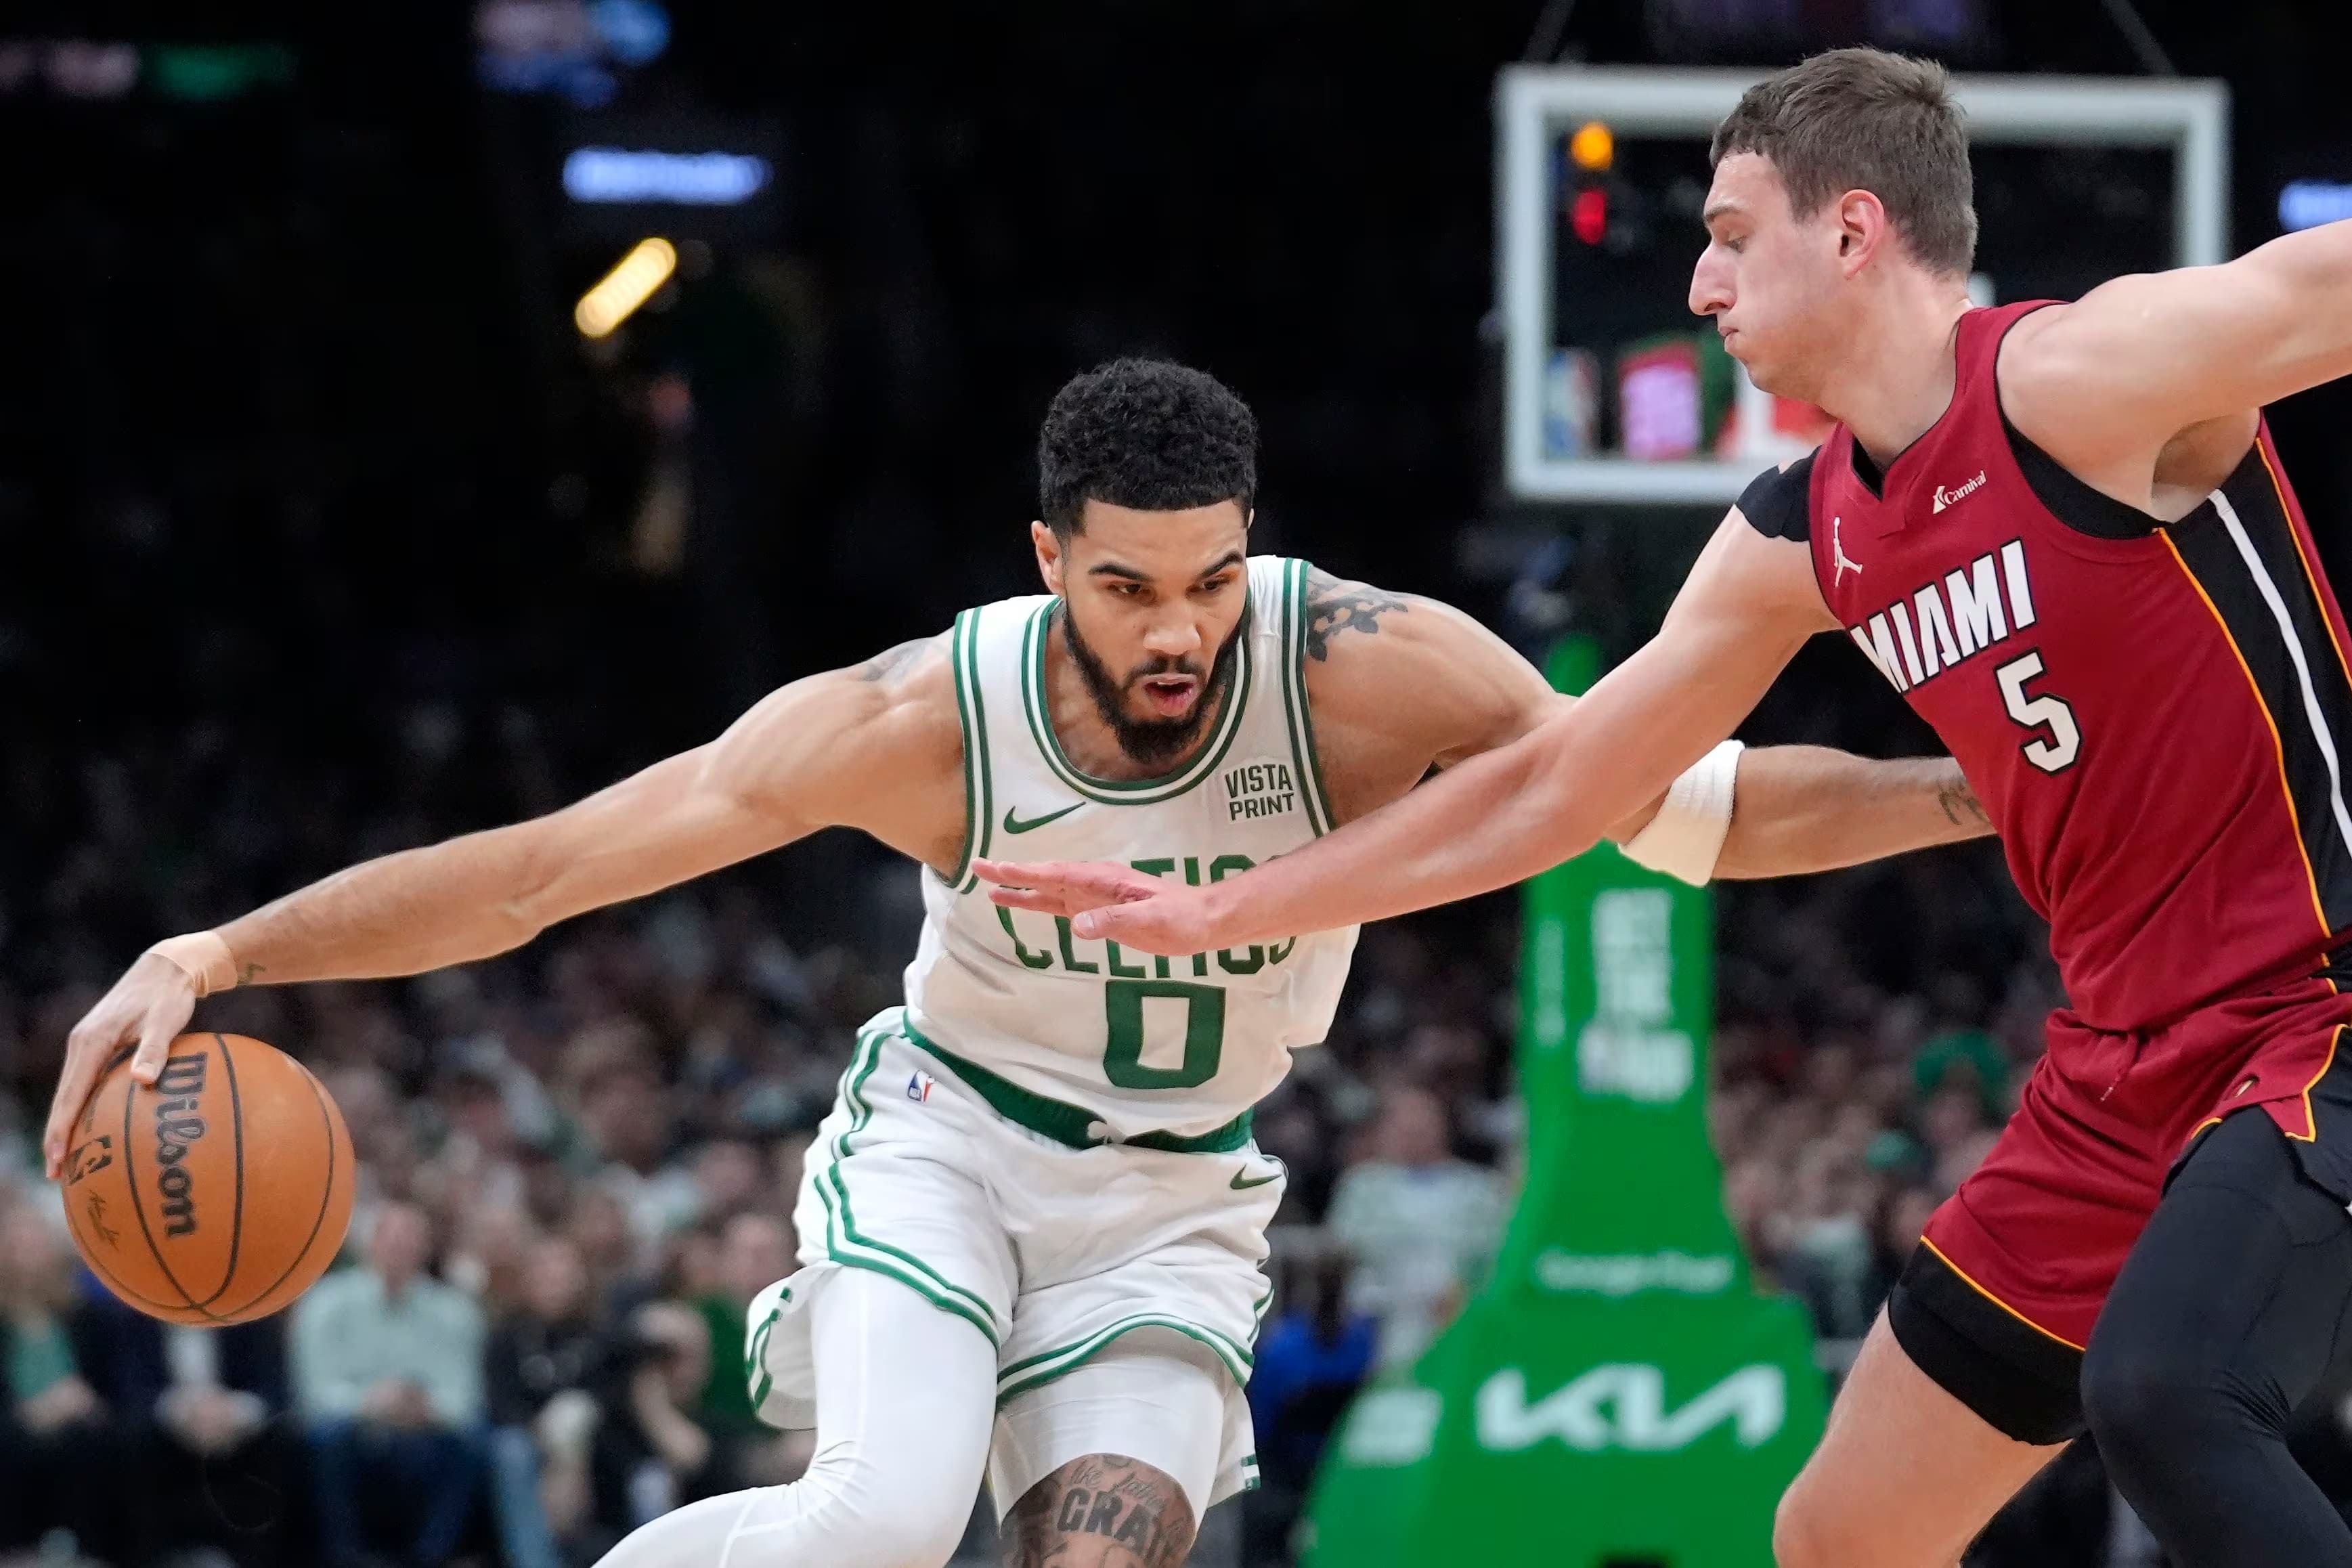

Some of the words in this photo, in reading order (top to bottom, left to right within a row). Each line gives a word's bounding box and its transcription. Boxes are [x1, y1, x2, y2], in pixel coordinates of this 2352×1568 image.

[1943, 469, 1987, 505] Carnival
[1849, 537, 2036, 694] MIAMI
[1994, 647, 2083, 775] 5
[1224, 763, 1294, 799] VISTA
[1229, 791, 1295, 821] PRINT
[1102, 979, 1227, 1090] 0
[155, 1051, 209, 1239] Wilson
